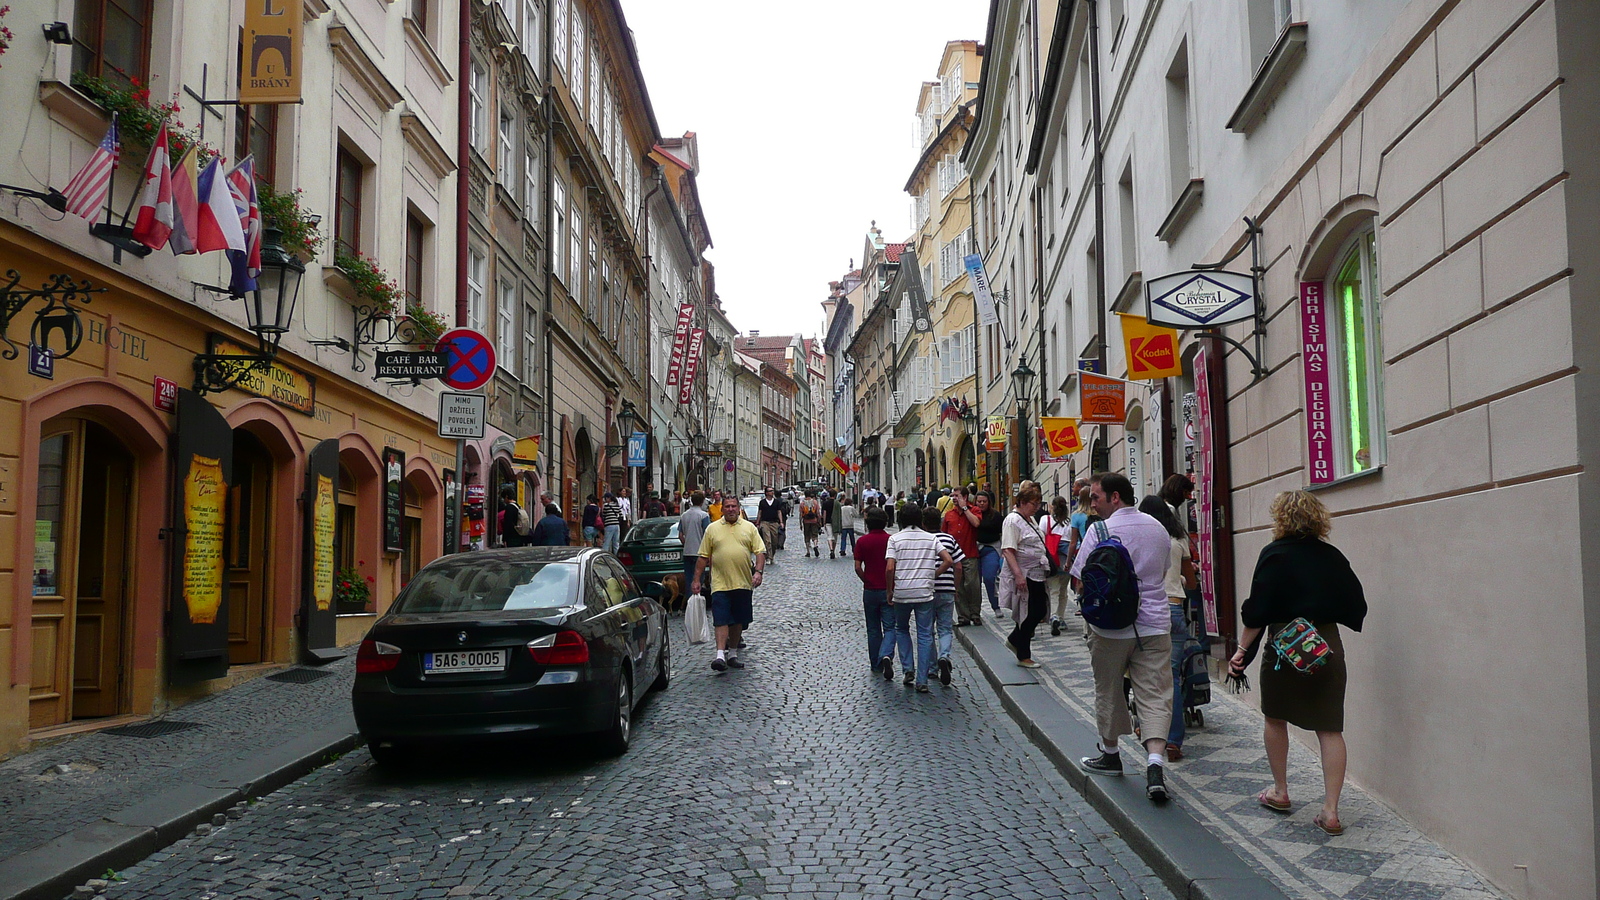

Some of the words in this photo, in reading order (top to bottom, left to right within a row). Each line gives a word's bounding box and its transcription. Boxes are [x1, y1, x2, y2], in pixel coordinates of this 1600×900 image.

[266, 65, 275, 73] U
[251, 77, 292, 88] BRÁNY
[973, 267, 986, 292] MARE
[1175, 291, 1227, 305] CRYSTAL
[1306, 286, 1324, 372] CHRISTMAS
[87, 319, 149, 361] HOTEL
[669, 307, 692, 383] PIZZERIA
[37, 350, 51, 367] 21
[386, 353, 411, 364] CAFÉ
[418, 356, 439, 364] BAR
[1142, 347, 1171, 358] Kodak
[379, 366, 445, 375] RESTAURANT
[160, 382, 175, 398] 246
[449, 405, 476, 415] DRŽITELE
[448, 417, 476, 425] POVOLENÍ
[989, 422, 1006, 436] 0%
[1311, 382, 1328, 479] DECORATION
[1057, 434, 1075, 443] Kodak
[629, 439, 645, 459] 0%
[435, 654, 458, 667] 5A6
[468, 652, 500, 666] 0005
